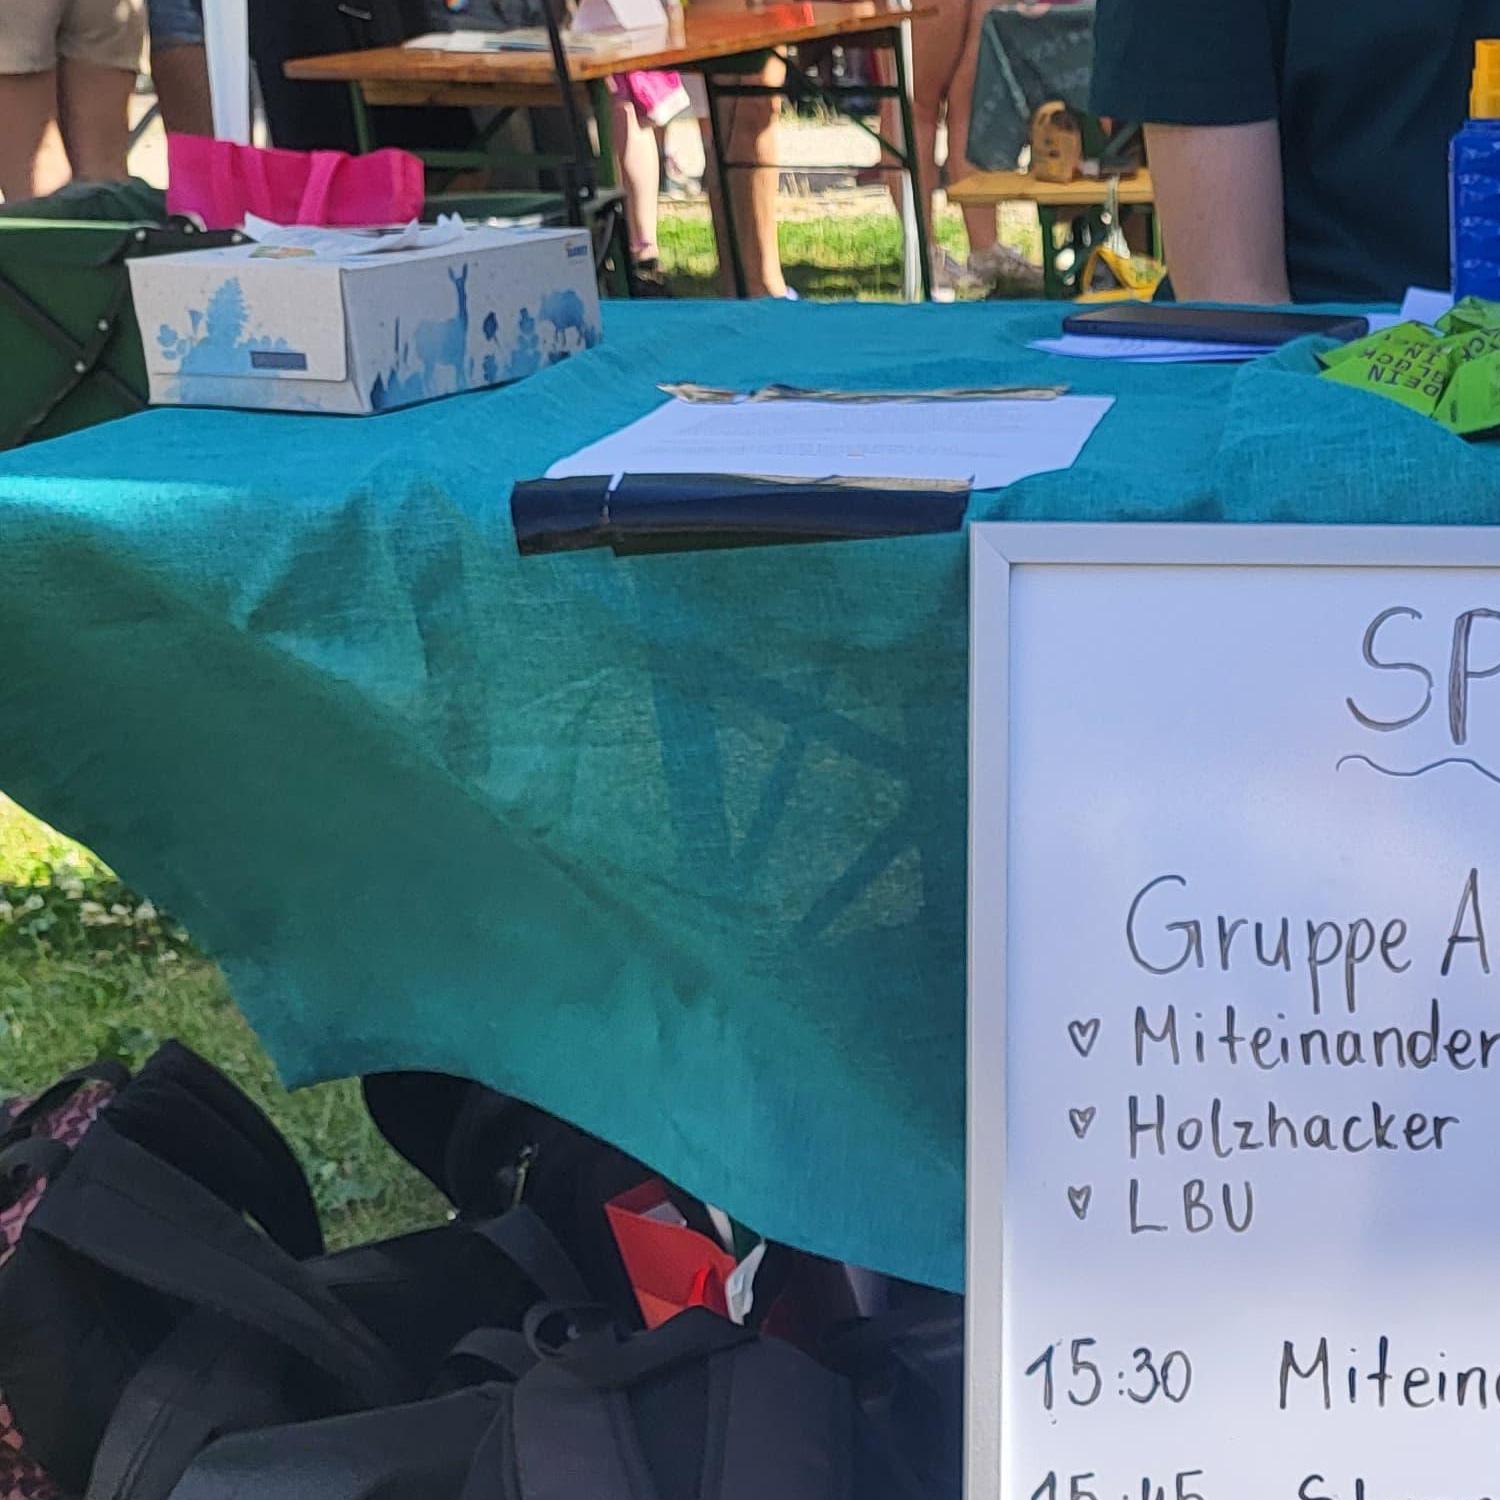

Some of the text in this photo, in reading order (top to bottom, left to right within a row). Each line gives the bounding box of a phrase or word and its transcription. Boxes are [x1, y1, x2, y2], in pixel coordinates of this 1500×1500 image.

[1367, 362, 1441, 397] DEIN
[1126, 875, 1412, 1016] Gruppe
[1128, 1094, 1459, 1159] Holzhacker
[1129, 1179, 1253, 1234] LBU
[1024, 1337, 1192, 1411] 15:30
